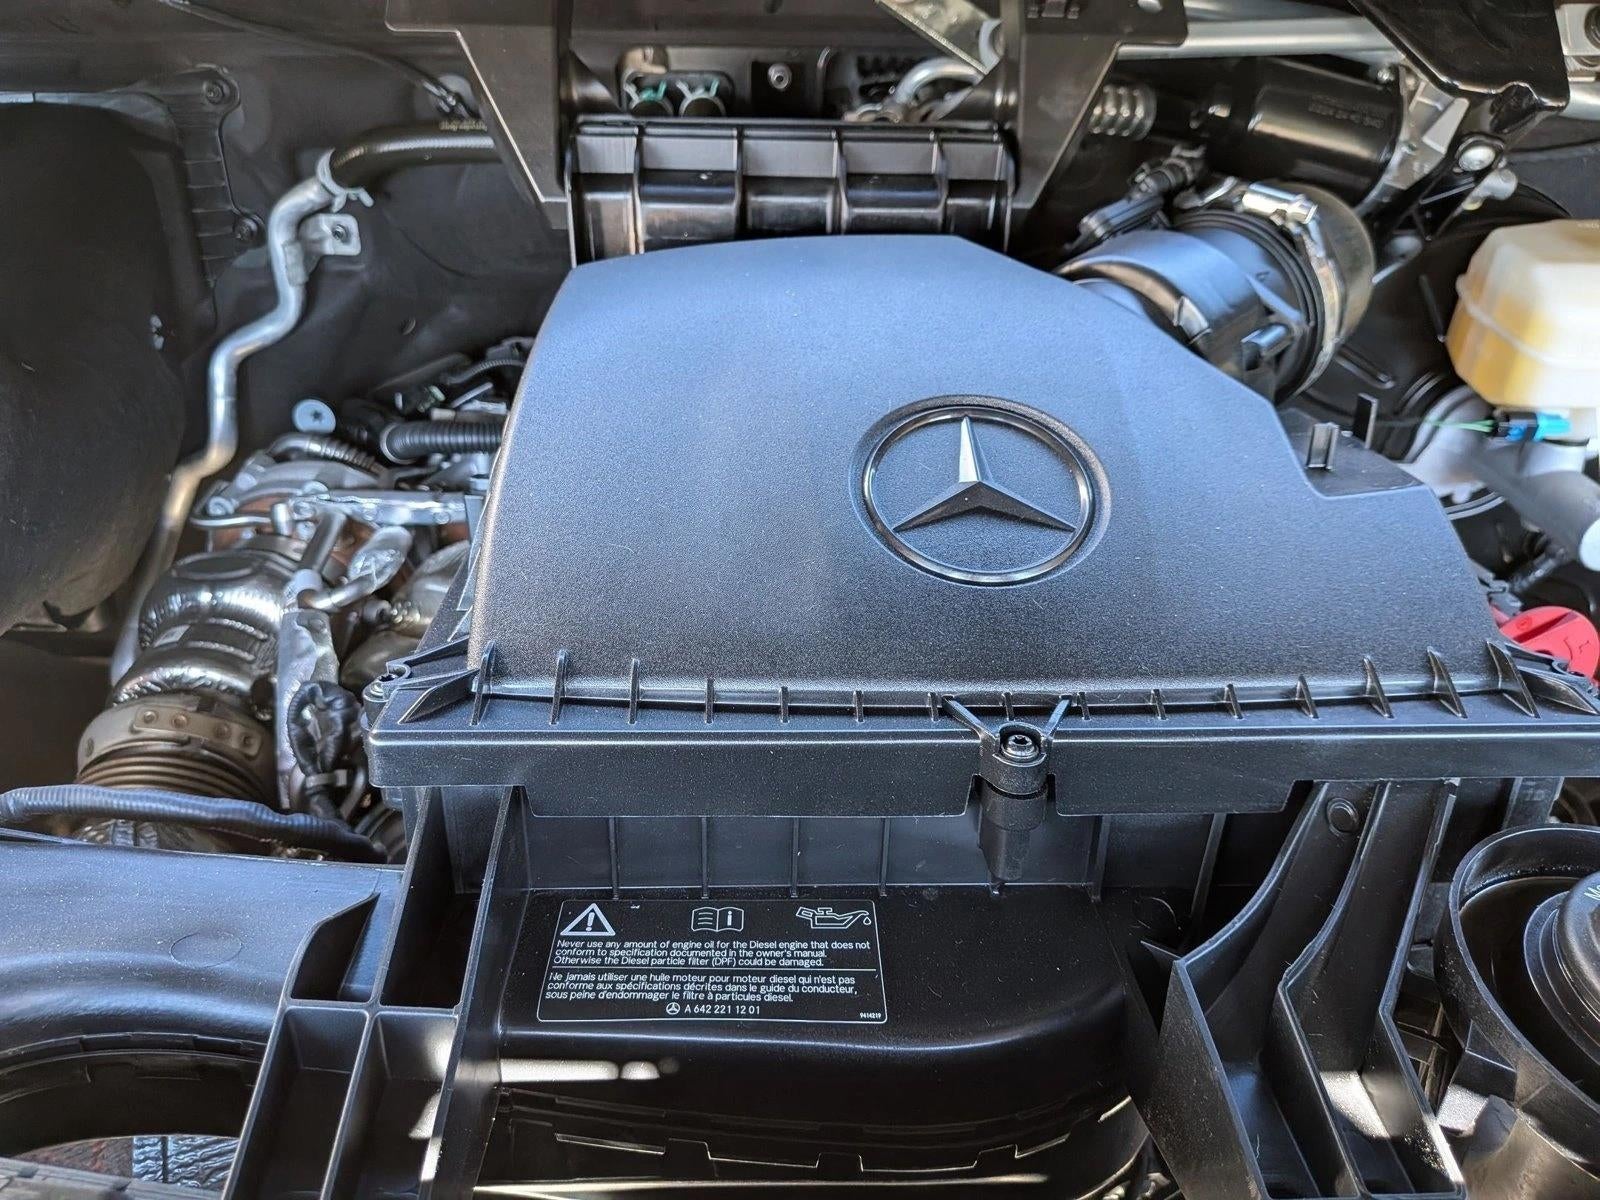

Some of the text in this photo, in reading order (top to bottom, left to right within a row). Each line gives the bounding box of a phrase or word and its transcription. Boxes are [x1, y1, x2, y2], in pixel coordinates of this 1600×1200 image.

[557, 940, 585, 948] Never
[672, 941, 702, 950] engine
[778, 941, 807, 950] engine
[810, 941, 828, 949] that
[651, 957, 685, 966] particle
[688, 957, 709, 965] filter
[712, 957, 736, 967] (DPF)
[779, 958, 824, 967] damaged.
[549, 973, 563, 981] Ne
[565, 973, 595, 982] jamais
[769, 975, 796, 983] diesel
[798, 975, 812, 984] qui
[814, 975, 836, 984] n'est
[548, 981, 594, 990] conforme
[616, 982, 681, 991] spécifications
[684, 982, 723, 991] décrites
[725, 983, 747, 992] dans
[760, 984, 785, 994] guide
[801, 984, 857, 995] conducteur,
[569, 990, 596, 1001] peine
[598, 991, 669, 1001] d'endommager
[682, 991, 705, 999] filtre
[707, 991, 713, 1000] à
[715, 992, 761, 1001] particules
[764, 993, 793, 1002] diesel.
[684, 1004, 760, 1014] A 642 221 12 01
